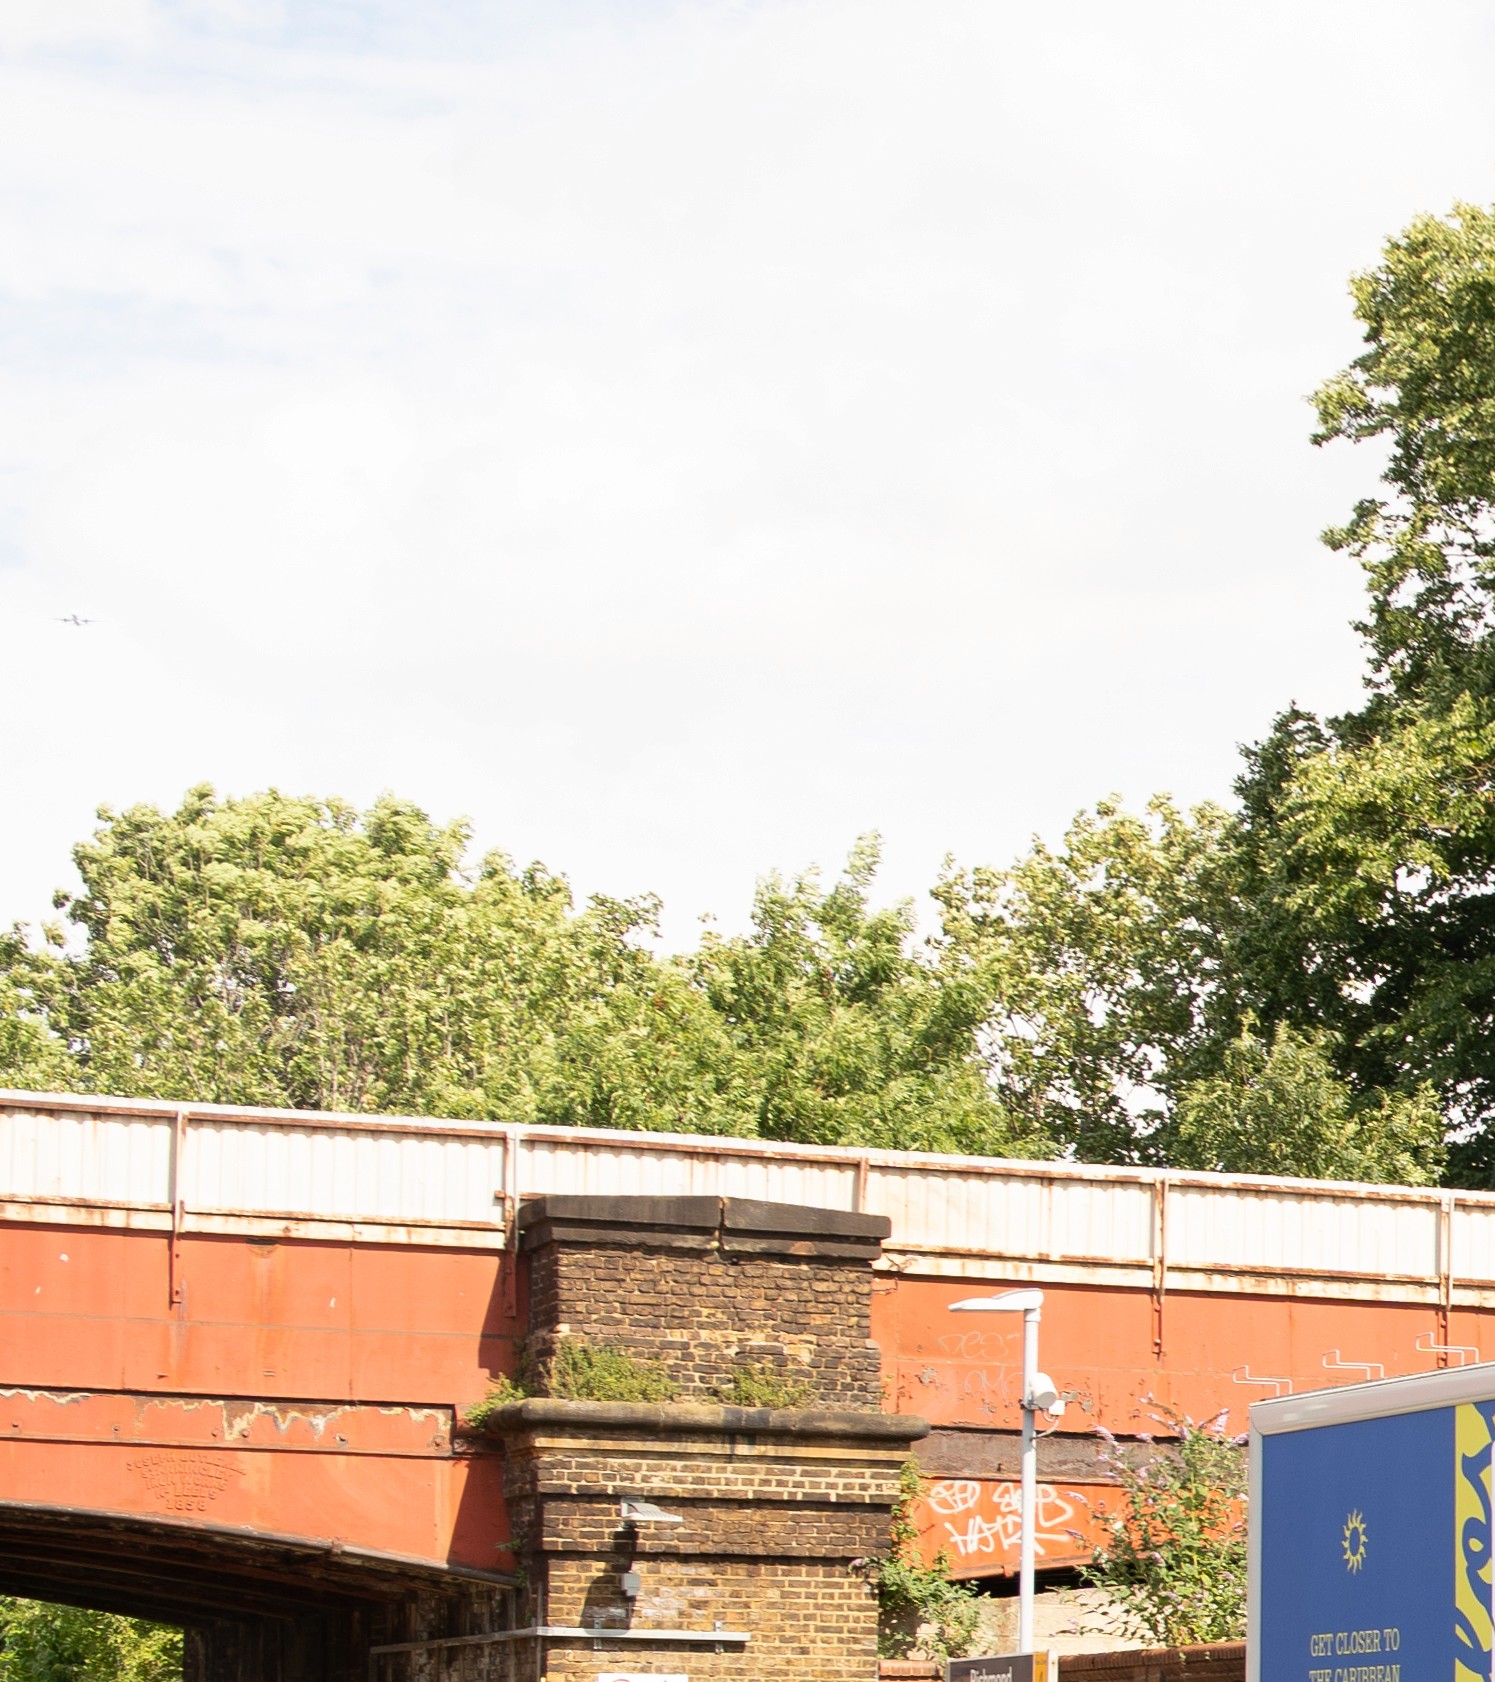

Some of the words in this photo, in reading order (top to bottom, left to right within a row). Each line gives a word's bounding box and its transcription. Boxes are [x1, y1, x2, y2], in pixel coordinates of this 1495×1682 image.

[1310, 1633, 1334, 1657] GET
[1335, 1629, 1382, 1655] CLOSER
[1383, 1627, 1400, 1651] TO
